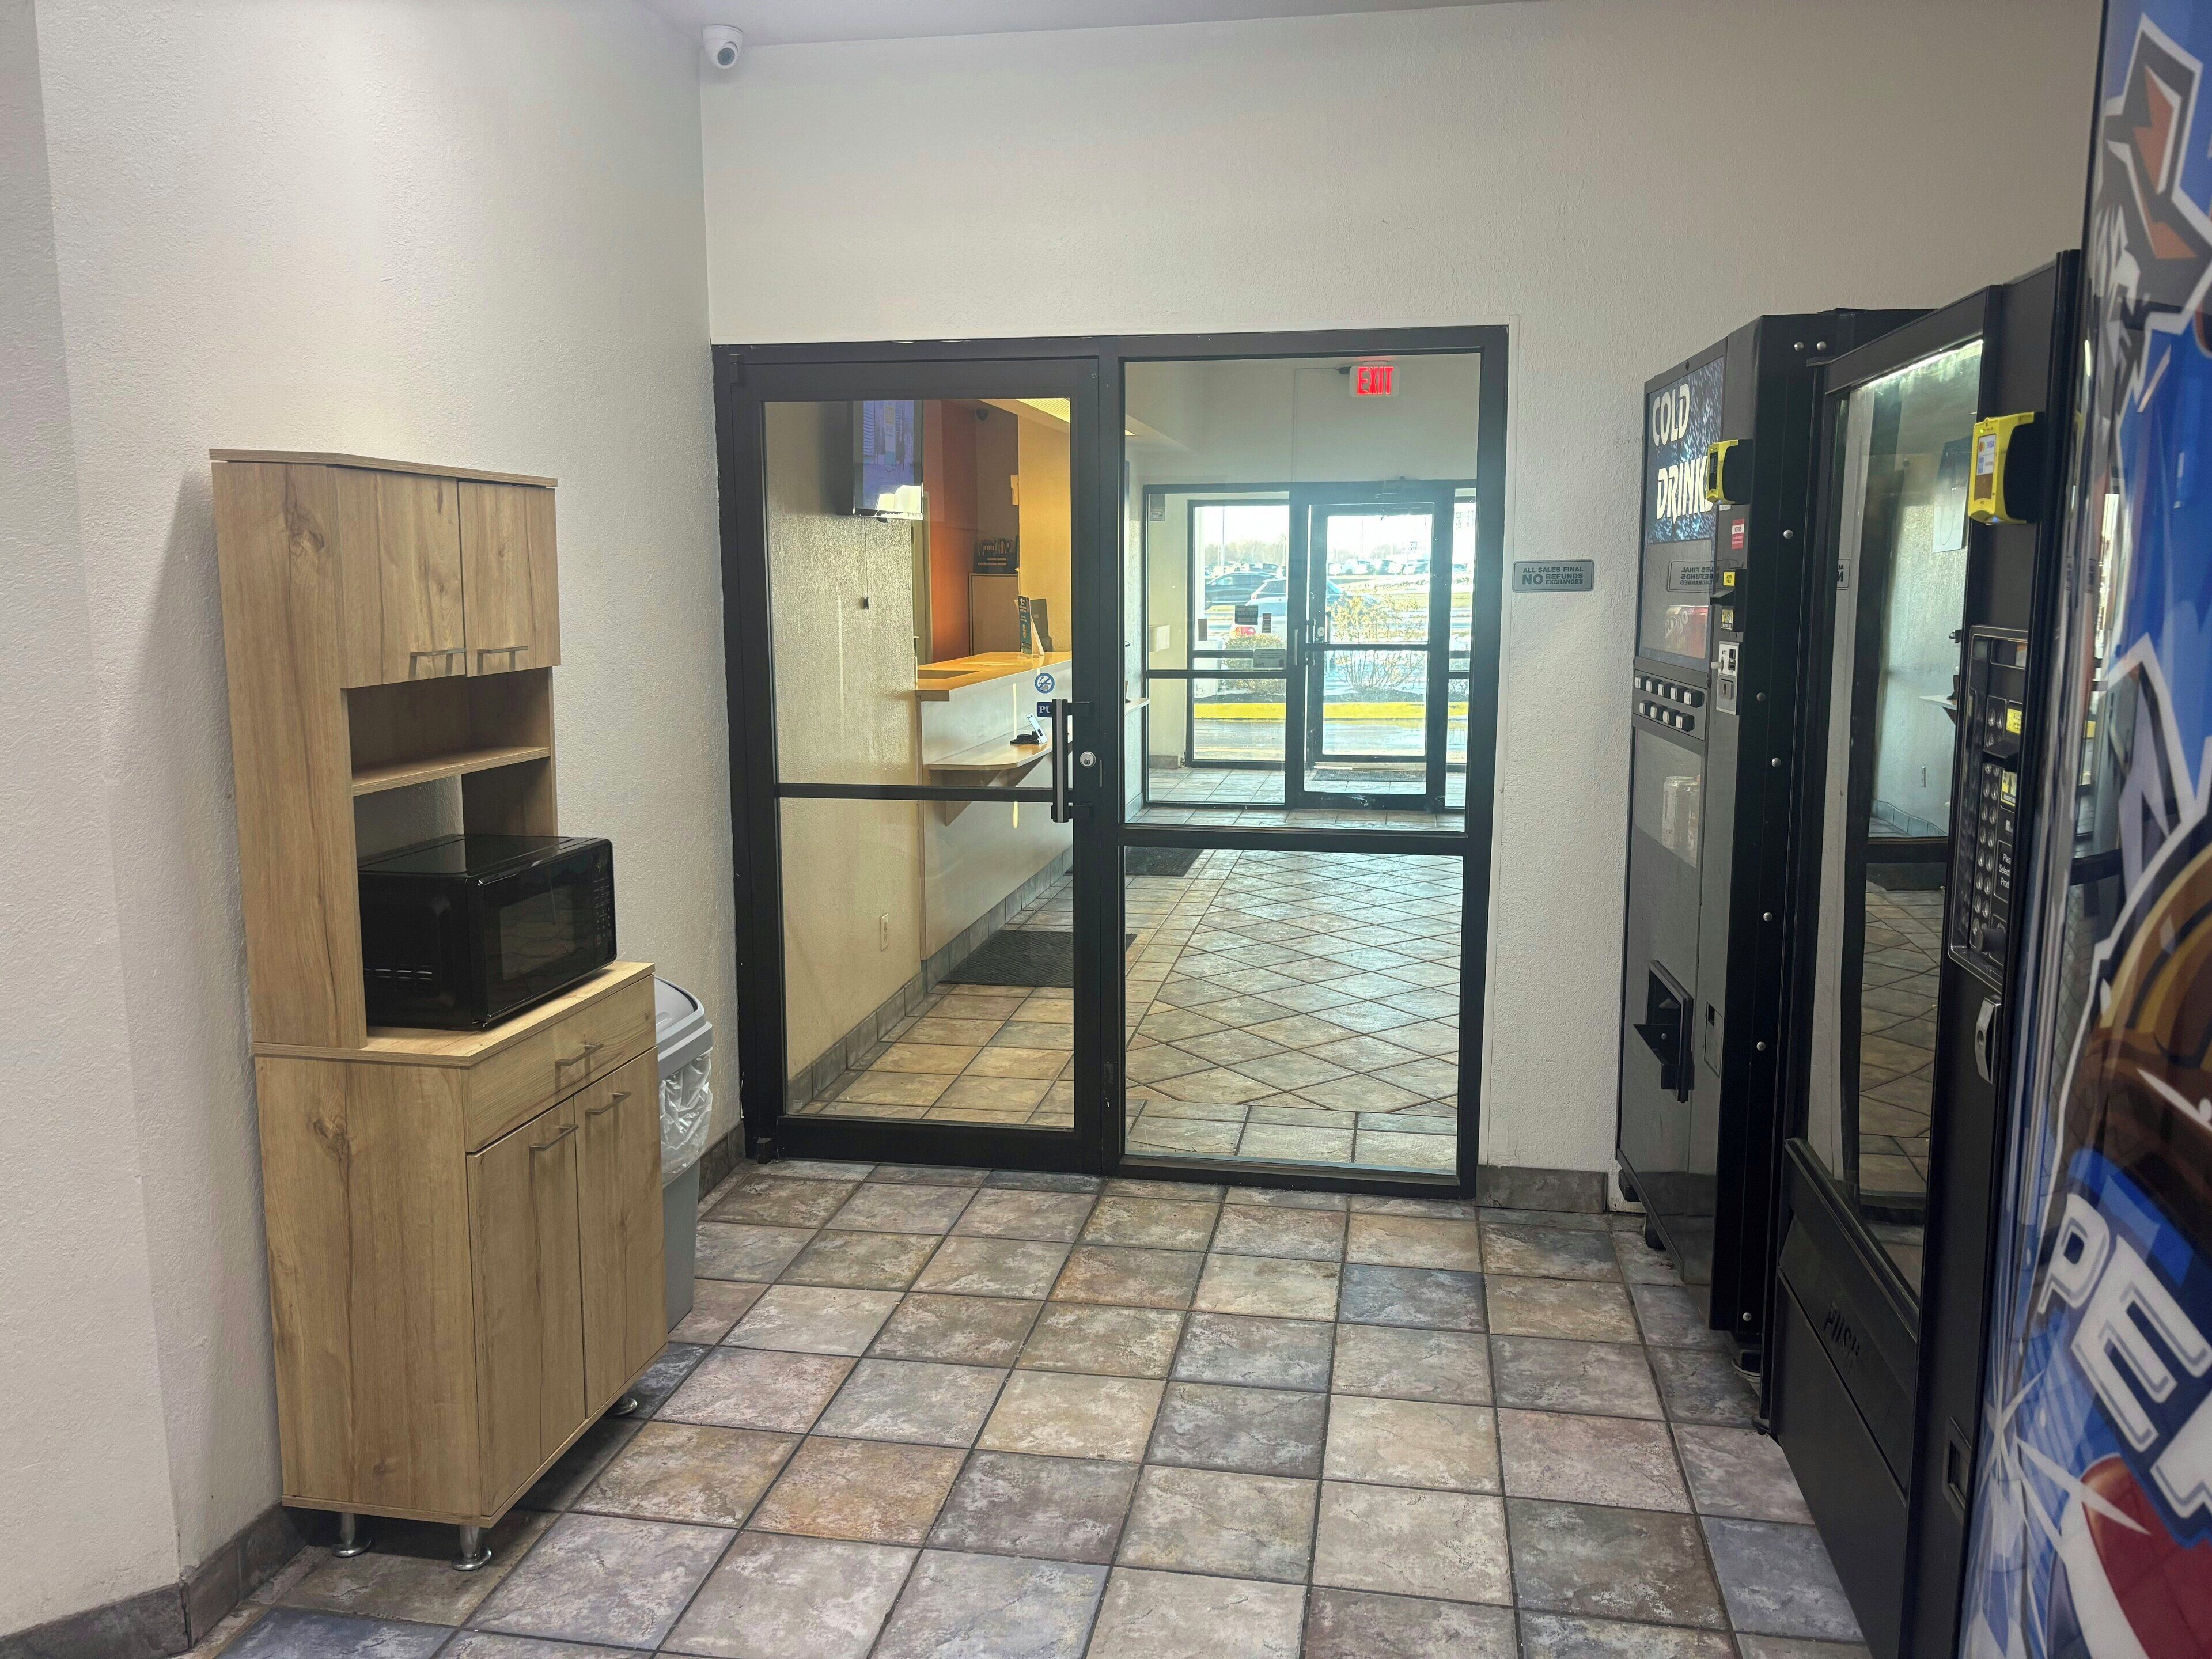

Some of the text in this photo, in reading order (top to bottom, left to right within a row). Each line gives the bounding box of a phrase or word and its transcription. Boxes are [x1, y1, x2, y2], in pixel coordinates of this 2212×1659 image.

[1357, 366, 1395, 395] EXIT
[1652, 382, 1690, 447] COLD
[1656, 456, 1713, 524] DRINK
[1522, 574, 1544, 585] NO
[1039, 706, 1051, 714] PU
